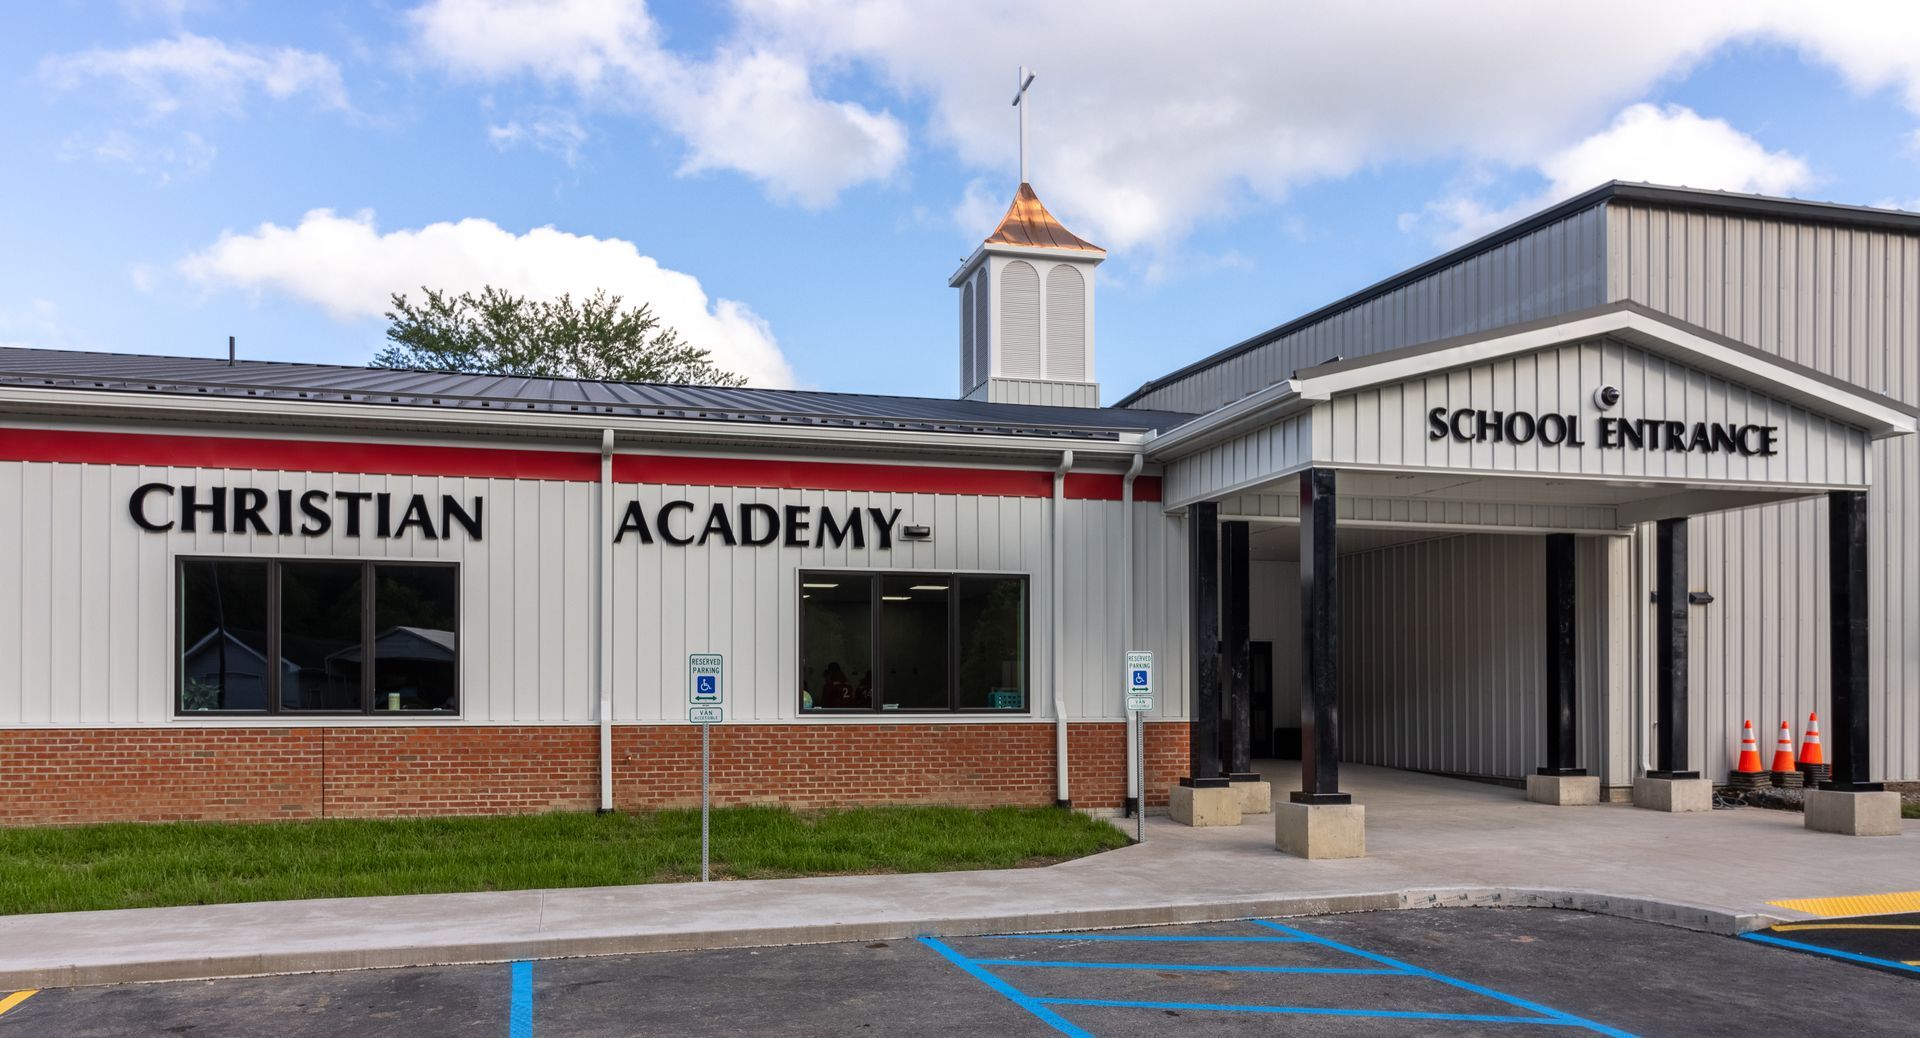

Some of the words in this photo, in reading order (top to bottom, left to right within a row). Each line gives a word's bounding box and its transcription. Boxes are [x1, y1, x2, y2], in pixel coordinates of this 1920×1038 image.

[1429, 406, 1584, 449] SCHOOL
[1597, 416, 1778, 457] ENTRANCE
[129, 483, 483, 541] CHRISTIAN
[613, 500, 902, 550] ACADEMY
[842, 687, 850, 698] 2
